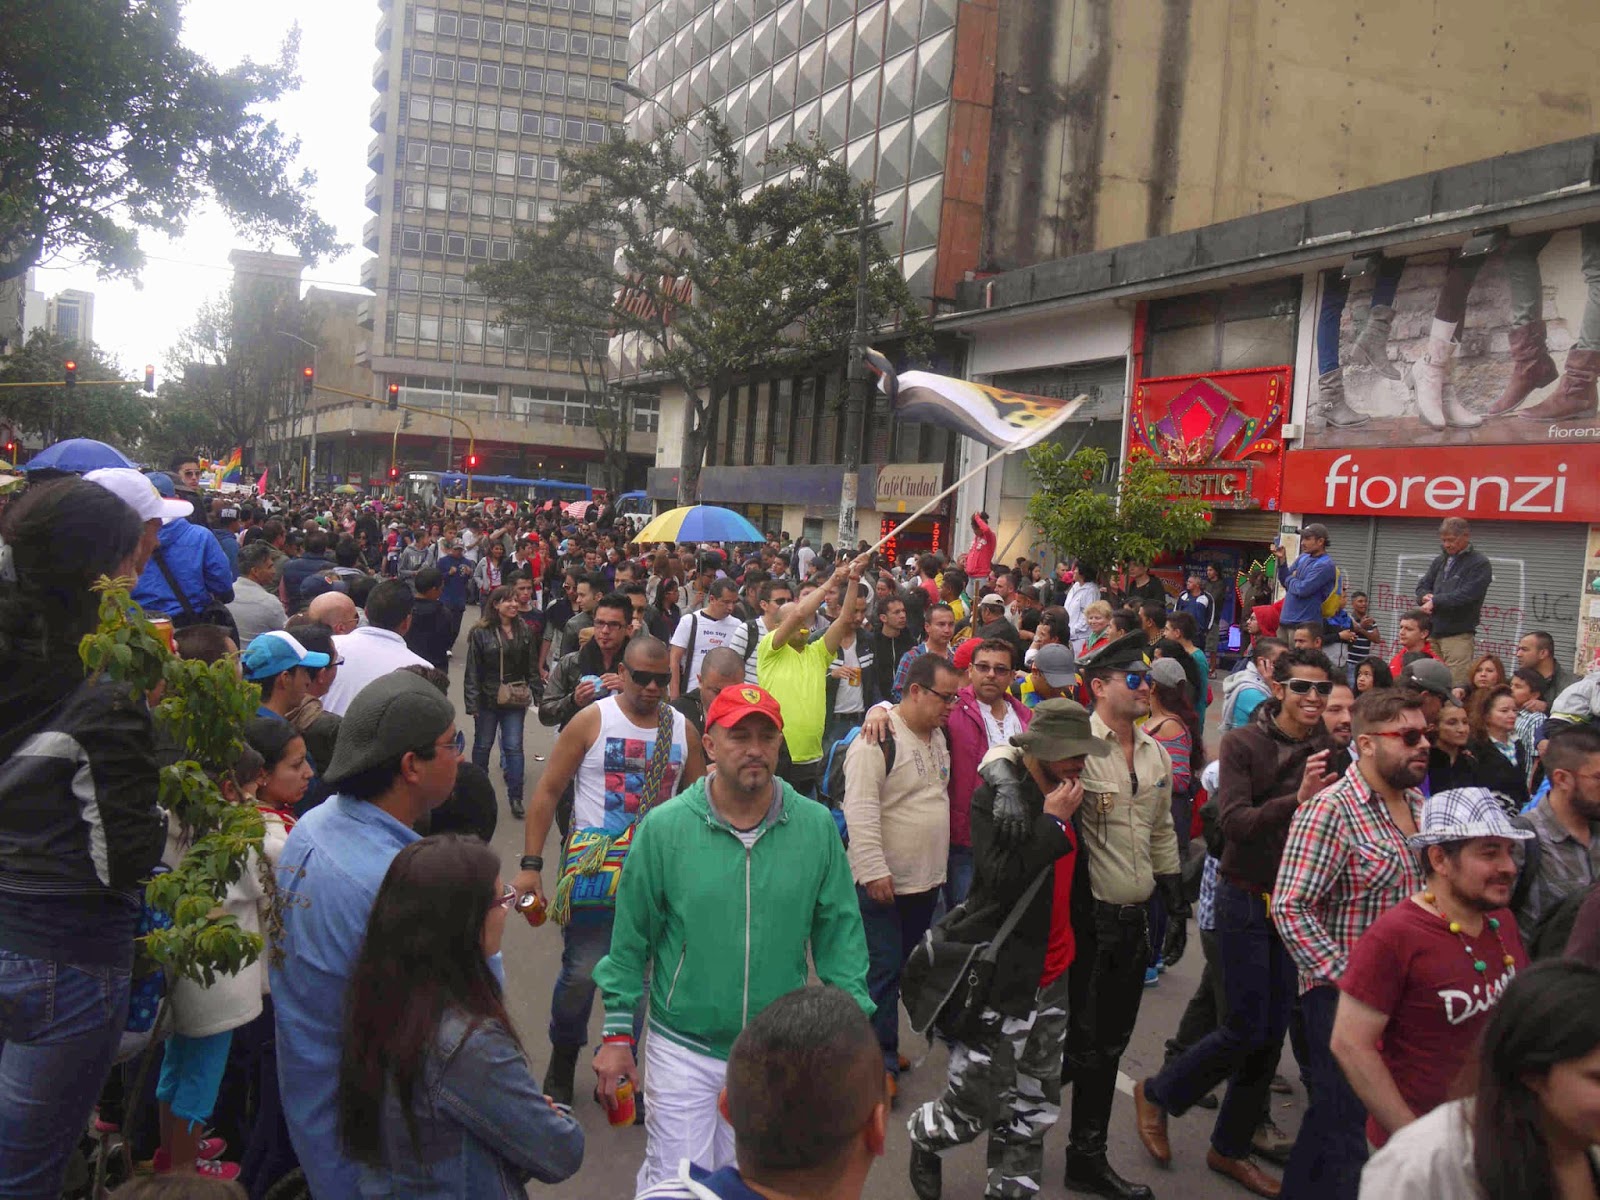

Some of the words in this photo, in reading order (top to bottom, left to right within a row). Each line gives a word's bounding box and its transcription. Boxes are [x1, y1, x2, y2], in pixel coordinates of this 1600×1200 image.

[877, 476, 899, 500] Café
[899, 475, 938, 496] Ciudad
[1325, 452, 1568, 513] fiorenzi
